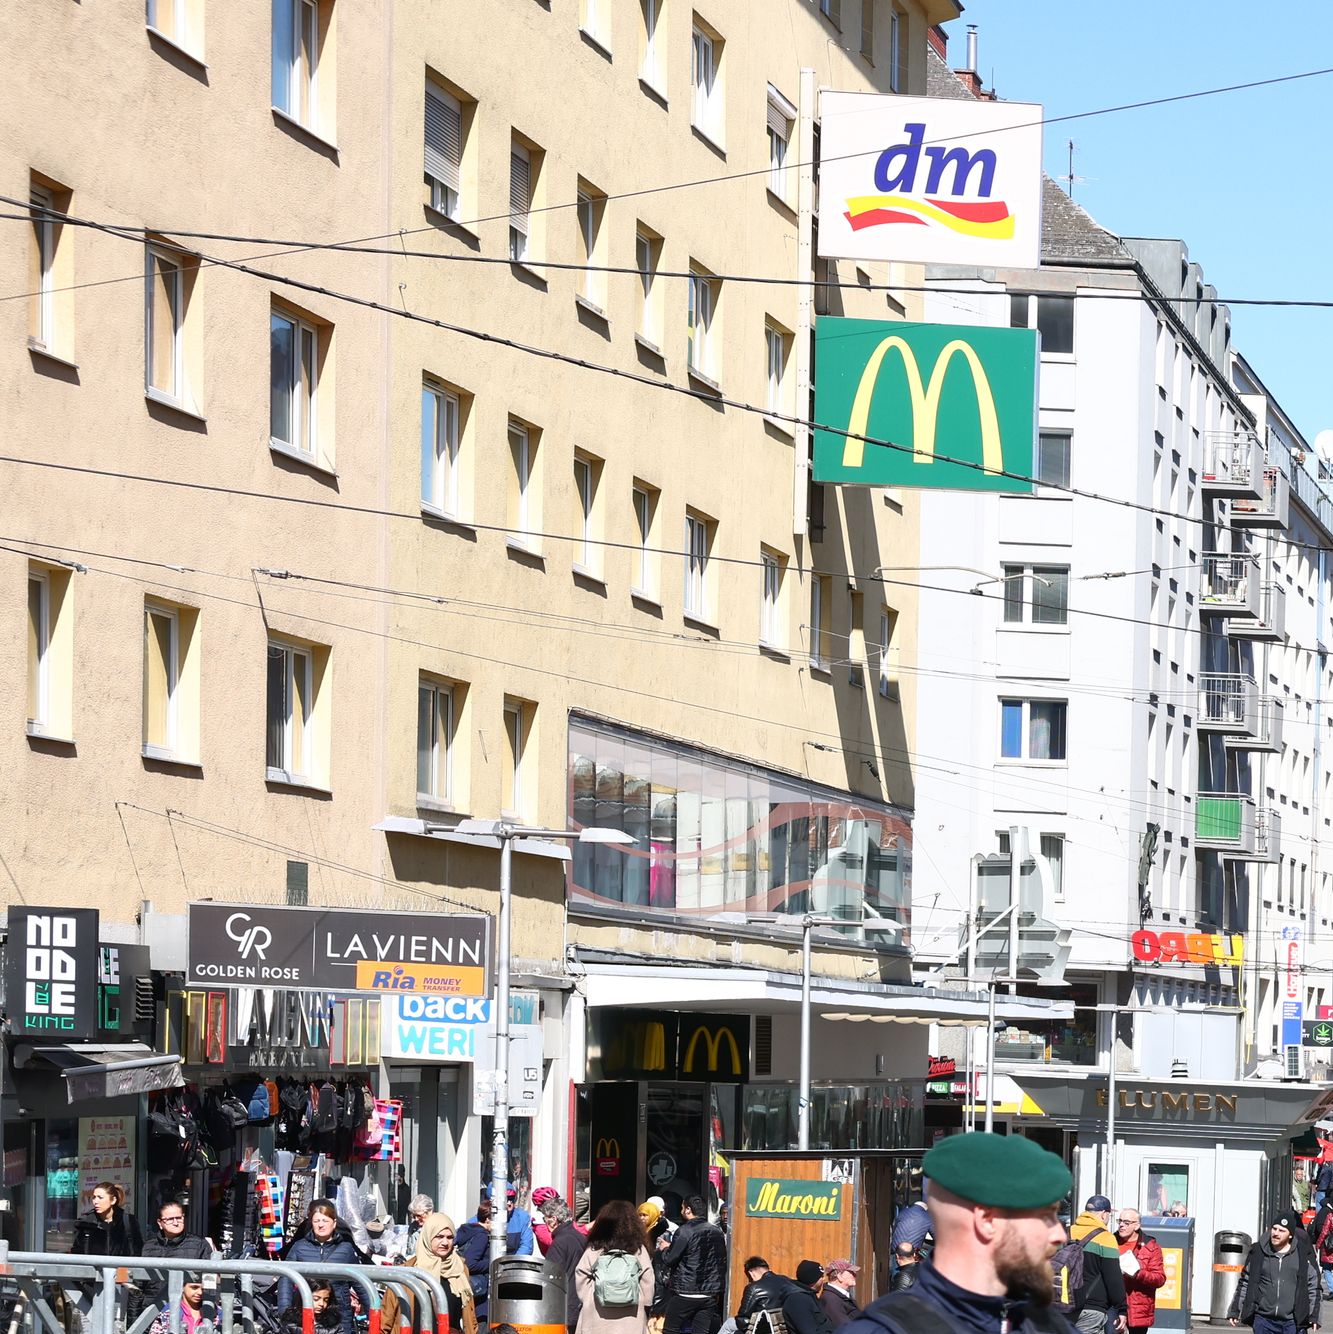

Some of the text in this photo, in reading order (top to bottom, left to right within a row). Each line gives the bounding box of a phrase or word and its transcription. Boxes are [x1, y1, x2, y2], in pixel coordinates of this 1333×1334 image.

[874, 123, 997, 198] dm
[327, 931, 481, 965] LAVIENN
[196, 963, 300, 980] GOLDEN ROSE
[372, 967, 416, 990] Ria
[423, 977, 462, 986] MONEY
[402, 995, 486, 1022] back
[24, 1016, 75, 1031] KING
[398, 1024, 474, 1057] WER
[749, 1181, 839, 1215] Maroni
